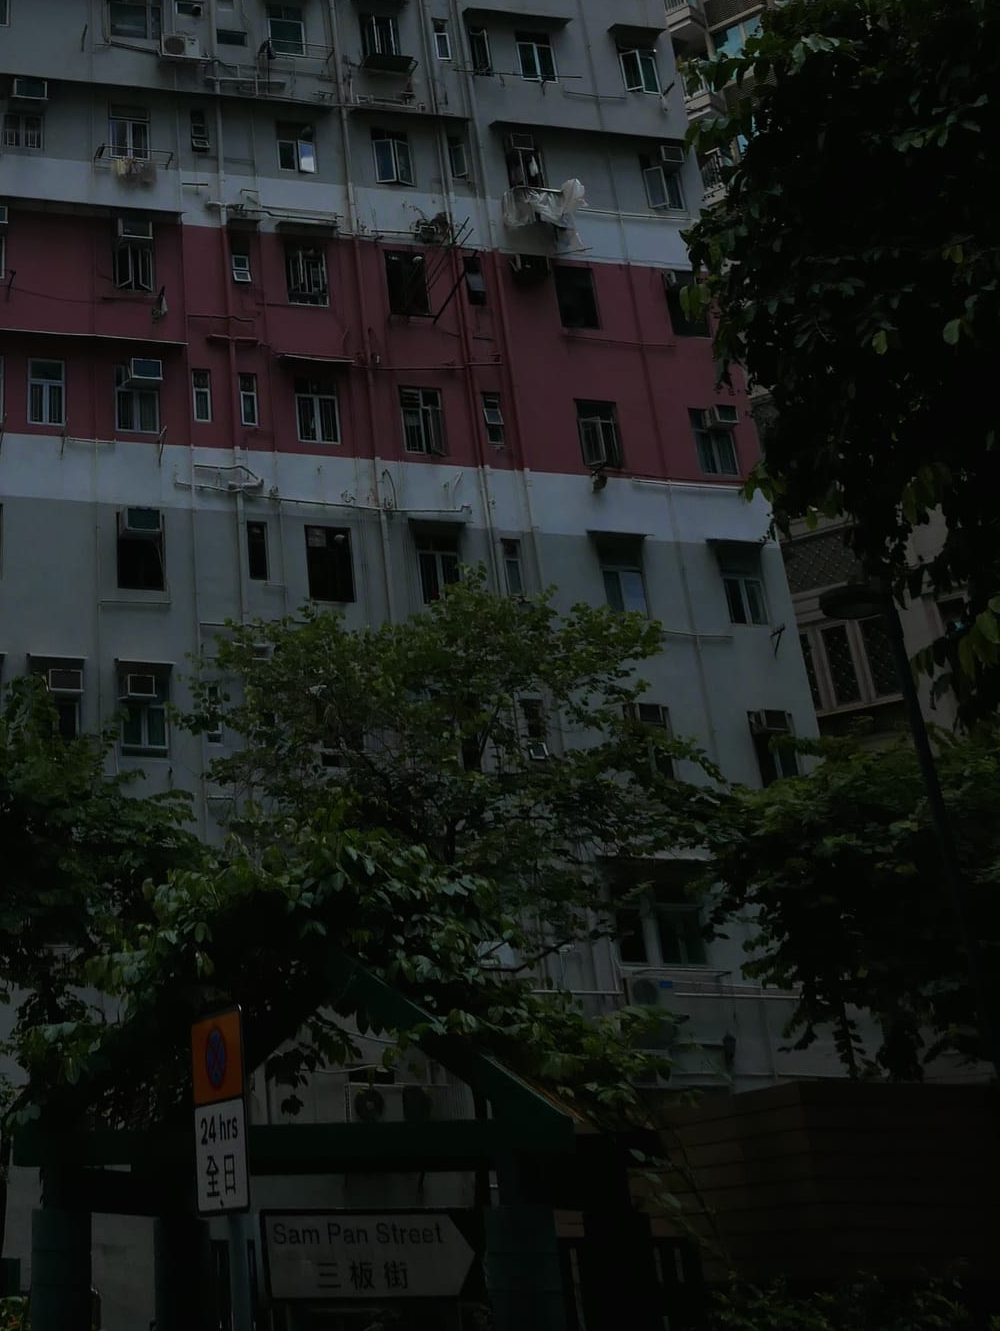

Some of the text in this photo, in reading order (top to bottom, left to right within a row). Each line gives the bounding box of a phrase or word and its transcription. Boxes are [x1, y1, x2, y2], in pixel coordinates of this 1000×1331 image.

[200, 1113, 238, 1145] 24 hrs
[206, 1154, 236, 1197] 全日
[273, 1222, 443, 1244] Sam Pan Street
[316, 1260, 408, 1290] 三板街
